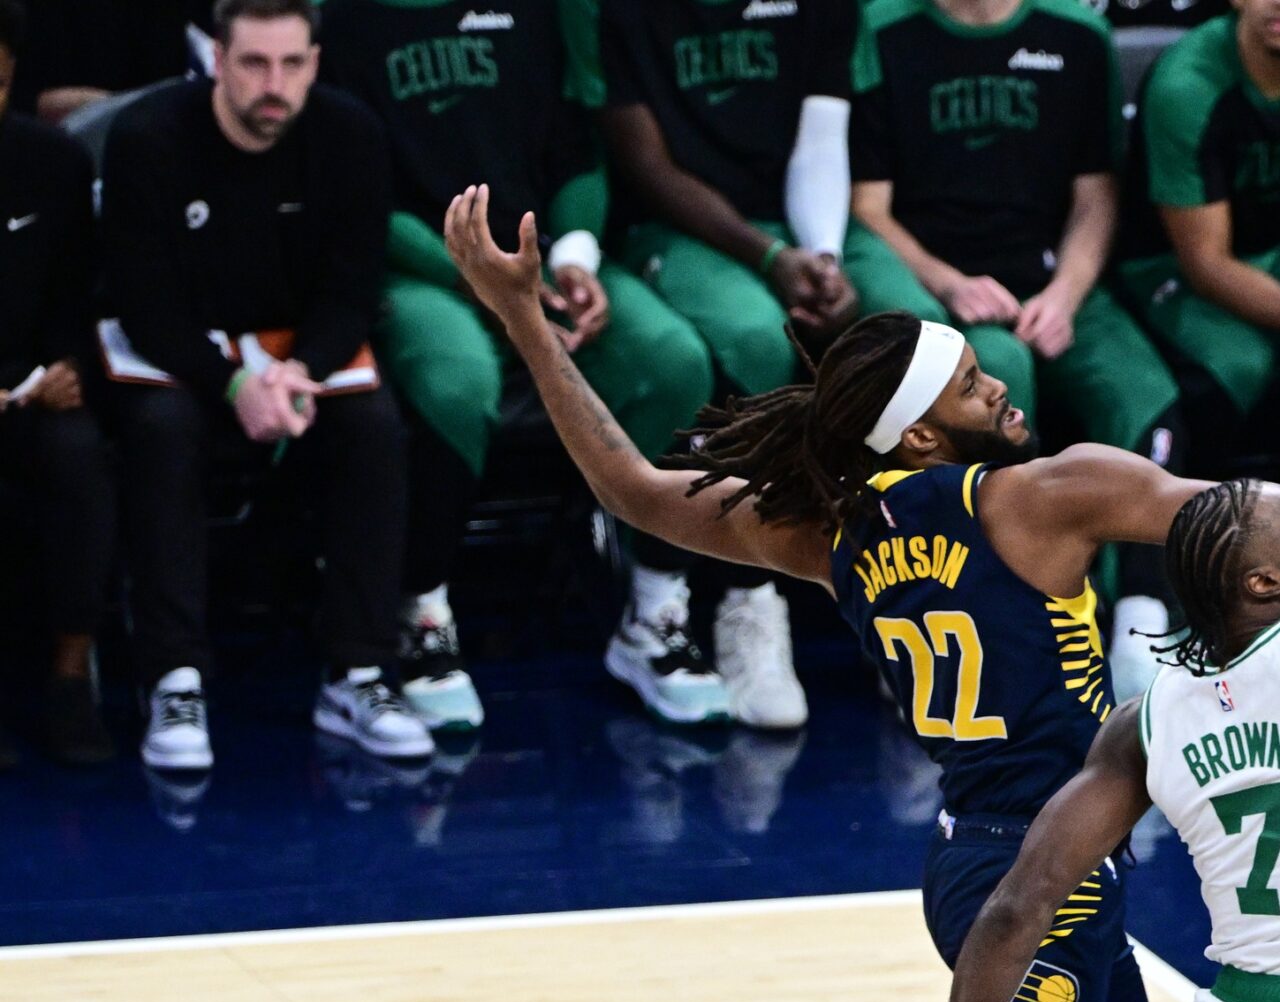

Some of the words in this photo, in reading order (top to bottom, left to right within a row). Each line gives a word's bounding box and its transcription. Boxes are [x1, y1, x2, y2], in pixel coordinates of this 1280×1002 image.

[386, 35, 499, 100] CELTICS
[929, 75, 1040, 133] CELTICS
[853, 534, 970, 604] JACKSON
[873, 611, 1008, 741] 22
